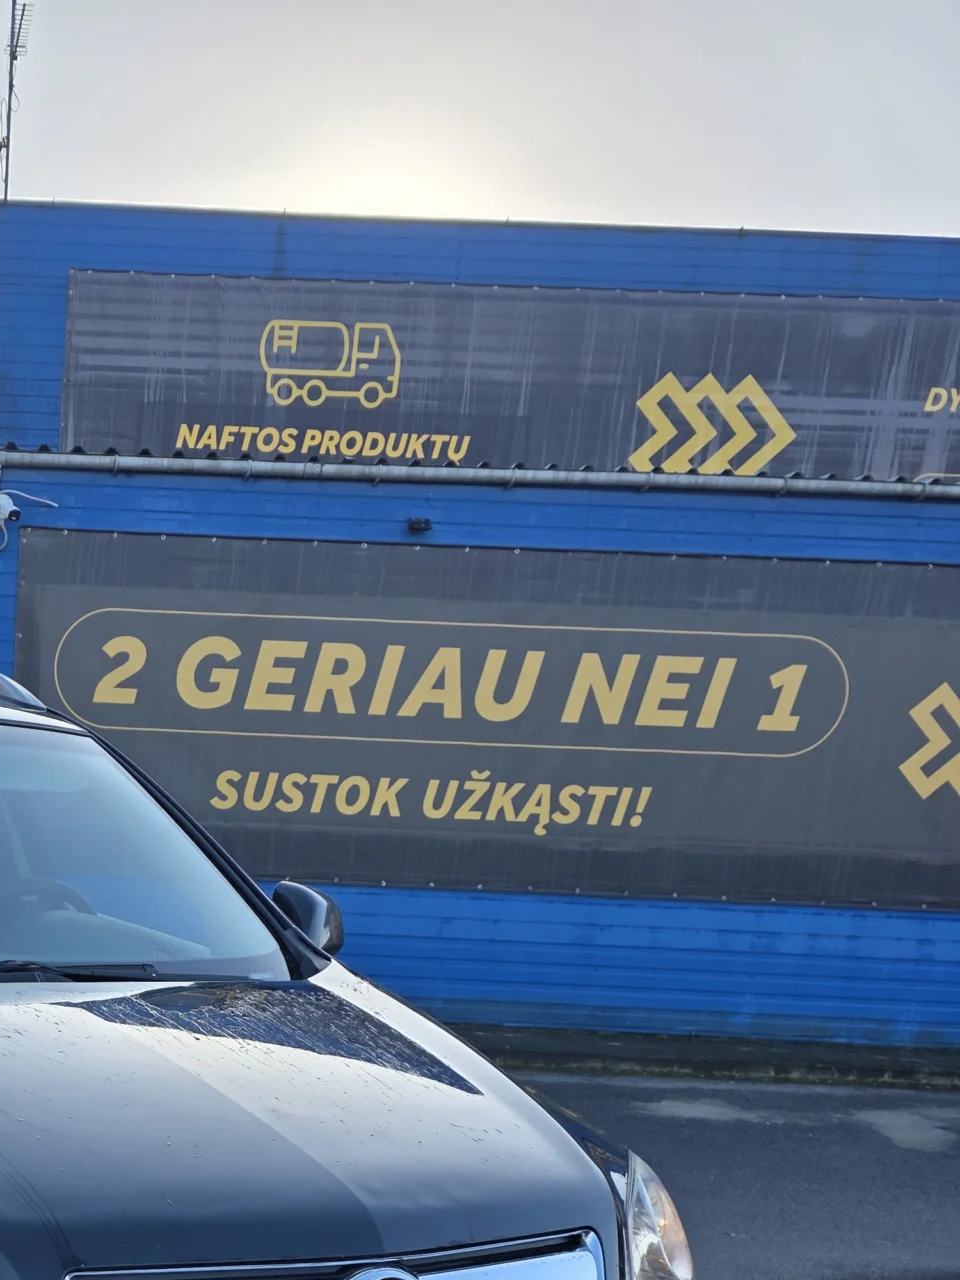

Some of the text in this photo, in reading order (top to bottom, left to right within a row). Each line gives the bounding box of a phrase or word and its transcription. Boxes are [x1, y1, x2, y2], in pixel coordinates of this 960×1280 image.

[175, 423, 299, 454] NAFTOS
[92, 635, 808, 732] 2 GERIAU NEI 1
[210, 769, 653, 836] SUSTOK UŽKĄSTI!
